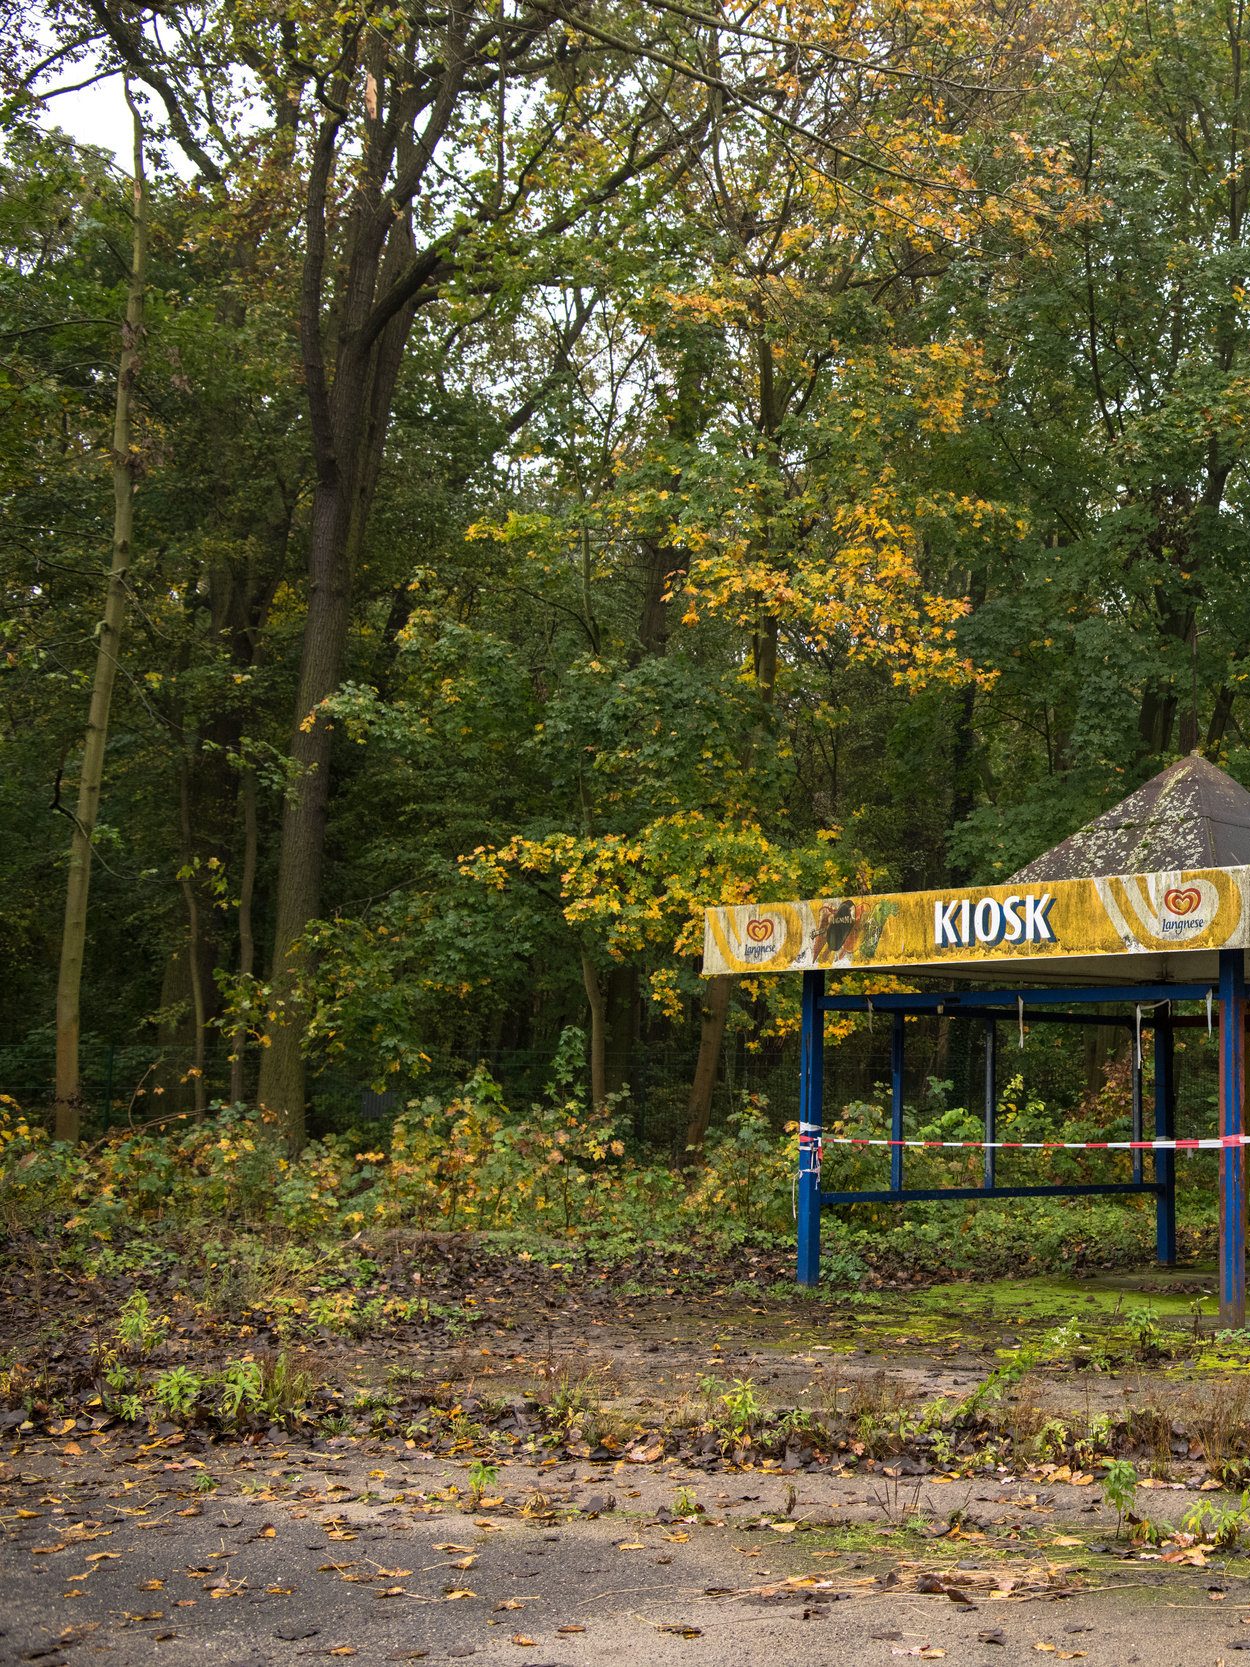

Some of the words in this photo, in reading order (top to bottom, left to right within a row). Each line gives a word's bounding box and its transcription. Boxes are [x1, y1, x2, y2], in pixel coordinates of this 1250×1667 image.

[935, 893, 1057, 948] KIOSK
[1162, 918, 1204, 935] Langnese
[744, 944, 776, 958] Langnese
